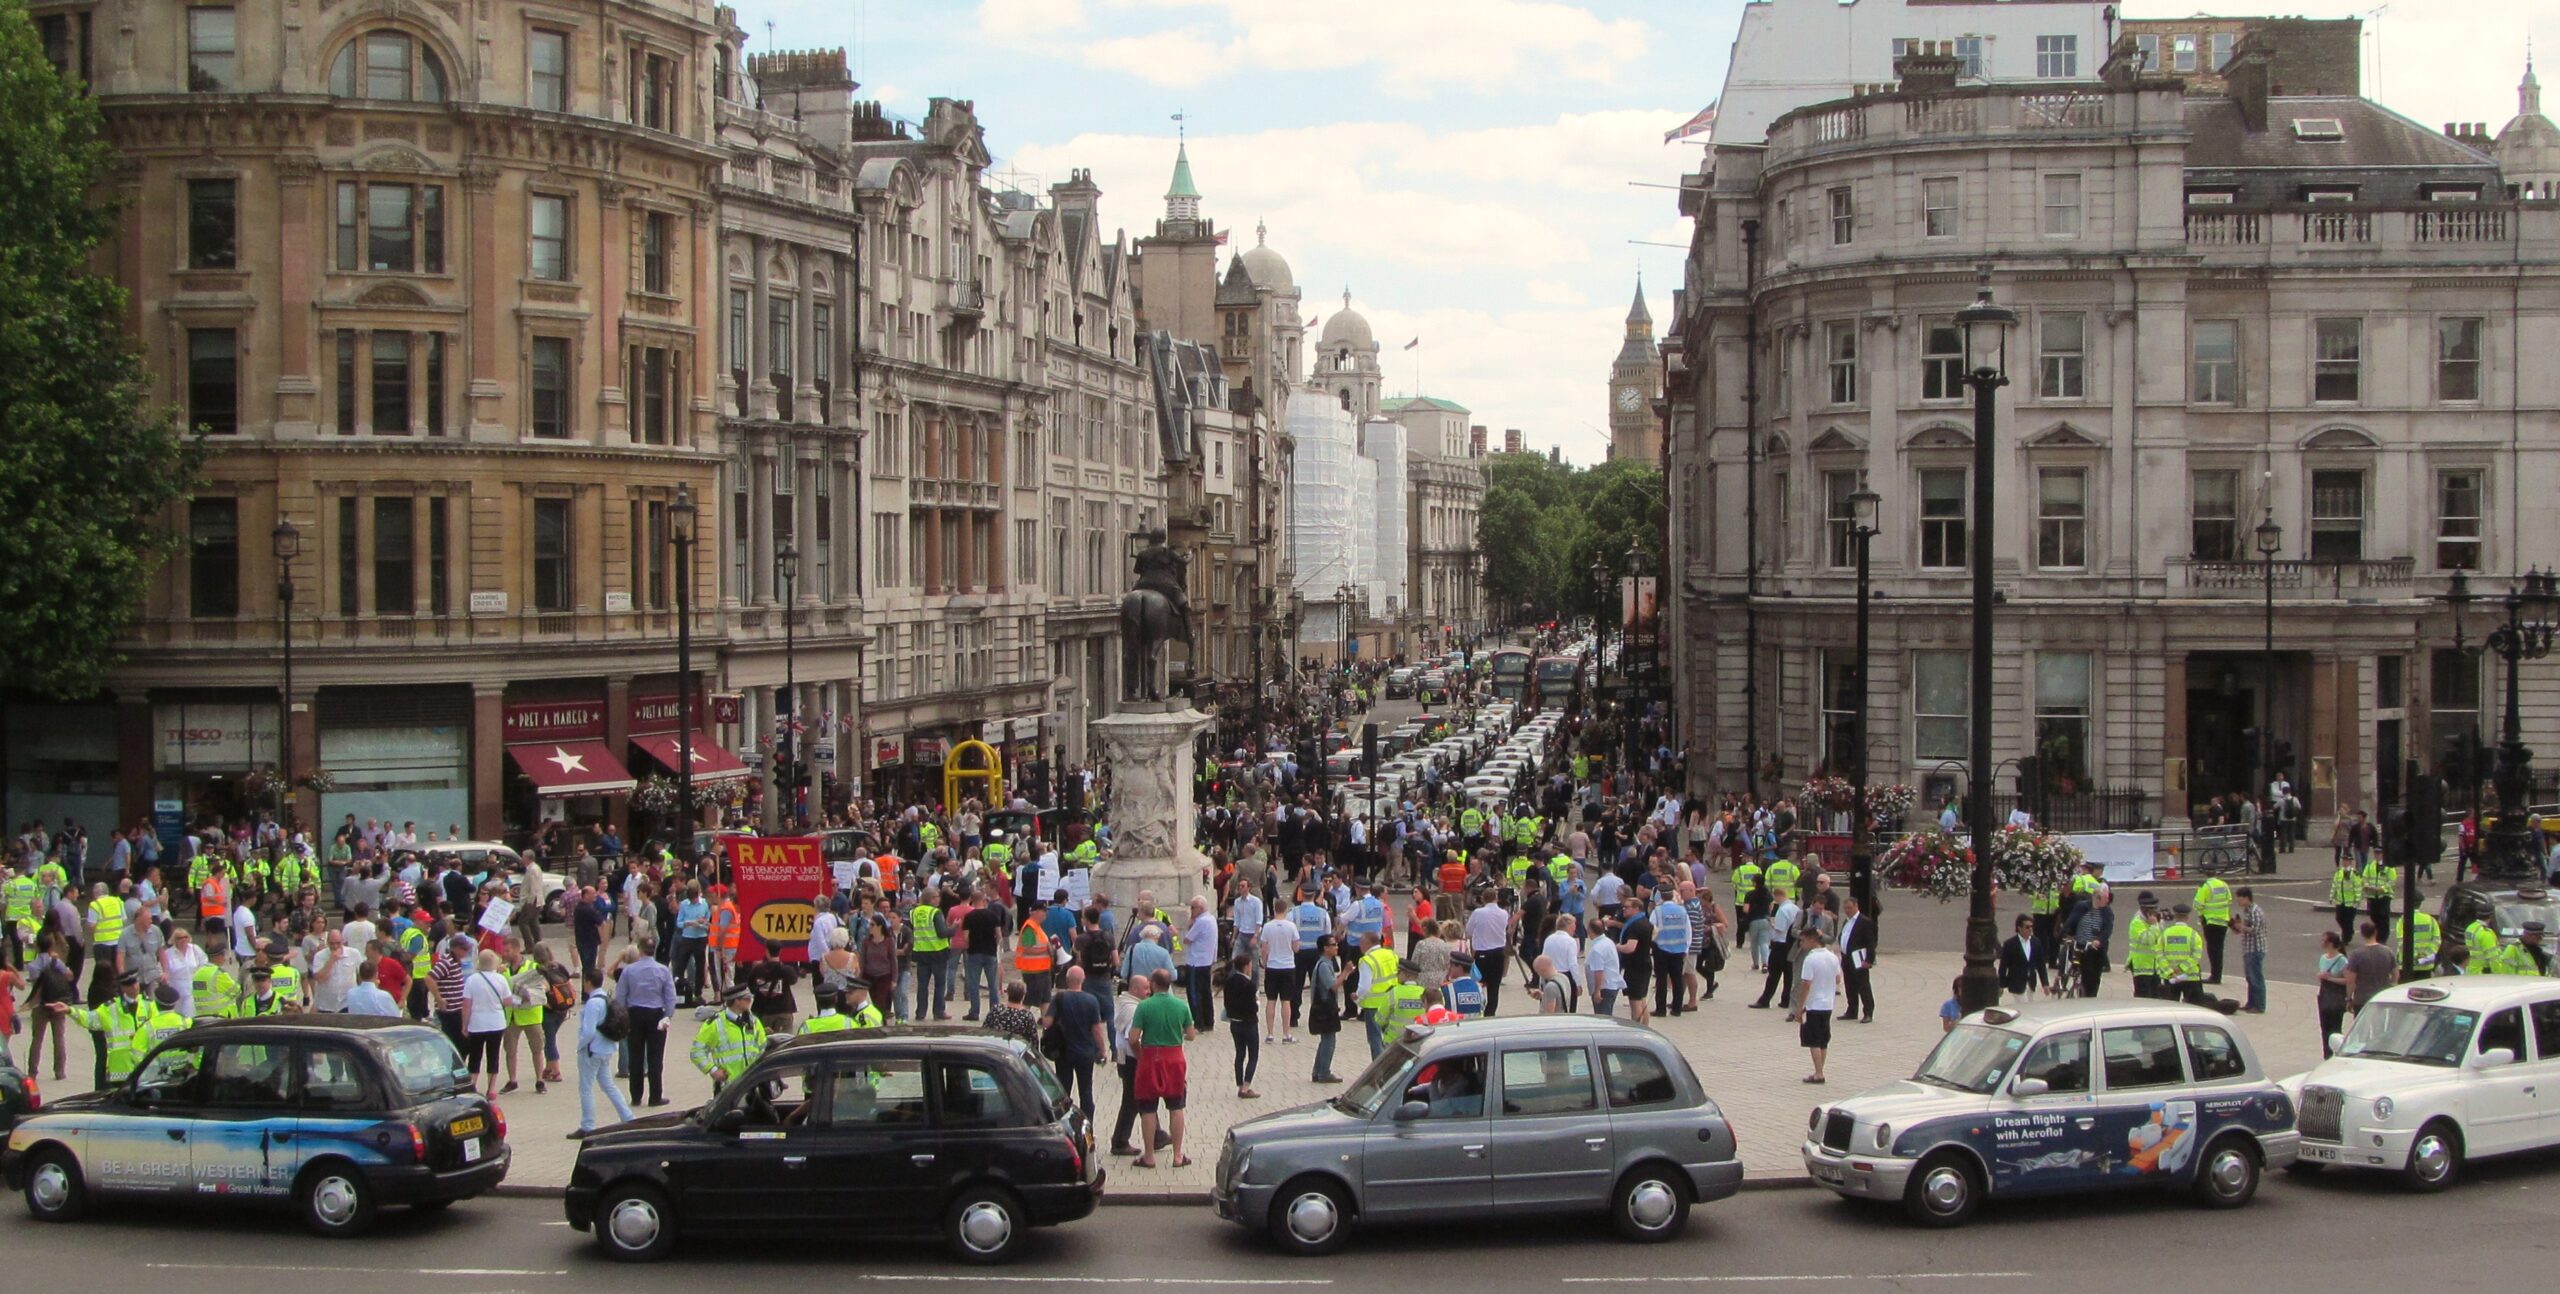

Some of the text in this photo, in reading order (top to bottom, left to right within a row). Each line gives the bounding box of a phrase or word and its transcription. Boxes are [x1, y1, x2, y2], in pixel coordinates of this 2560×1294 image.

[518, 709, 588, 727] PRET A MANGER
[642, 704, 656, 720] PRET
[657, 704, 662, 718] A
[166, 729, 222, 740] TESCO
[737, 843, 812, 864] RMT
[741, 866, 755, 874] THE
[755, 865, 798, 875] DEMOCRATIC
[765, 913, 814, 933] TAXIS
[2204, 1100, 2242, 1108] AEROFLOT
[1995, 1113, 2066, 1128] Dream flights
[1996, 1127, 2063, 1141] with Aeroflot
[103, 1160, 121, 1175] BE
[127, 1161, 137, 1175] A
[140, 1161, 189, 1177] GREAT
[198, 1183, 290, 1195] First Great Western
